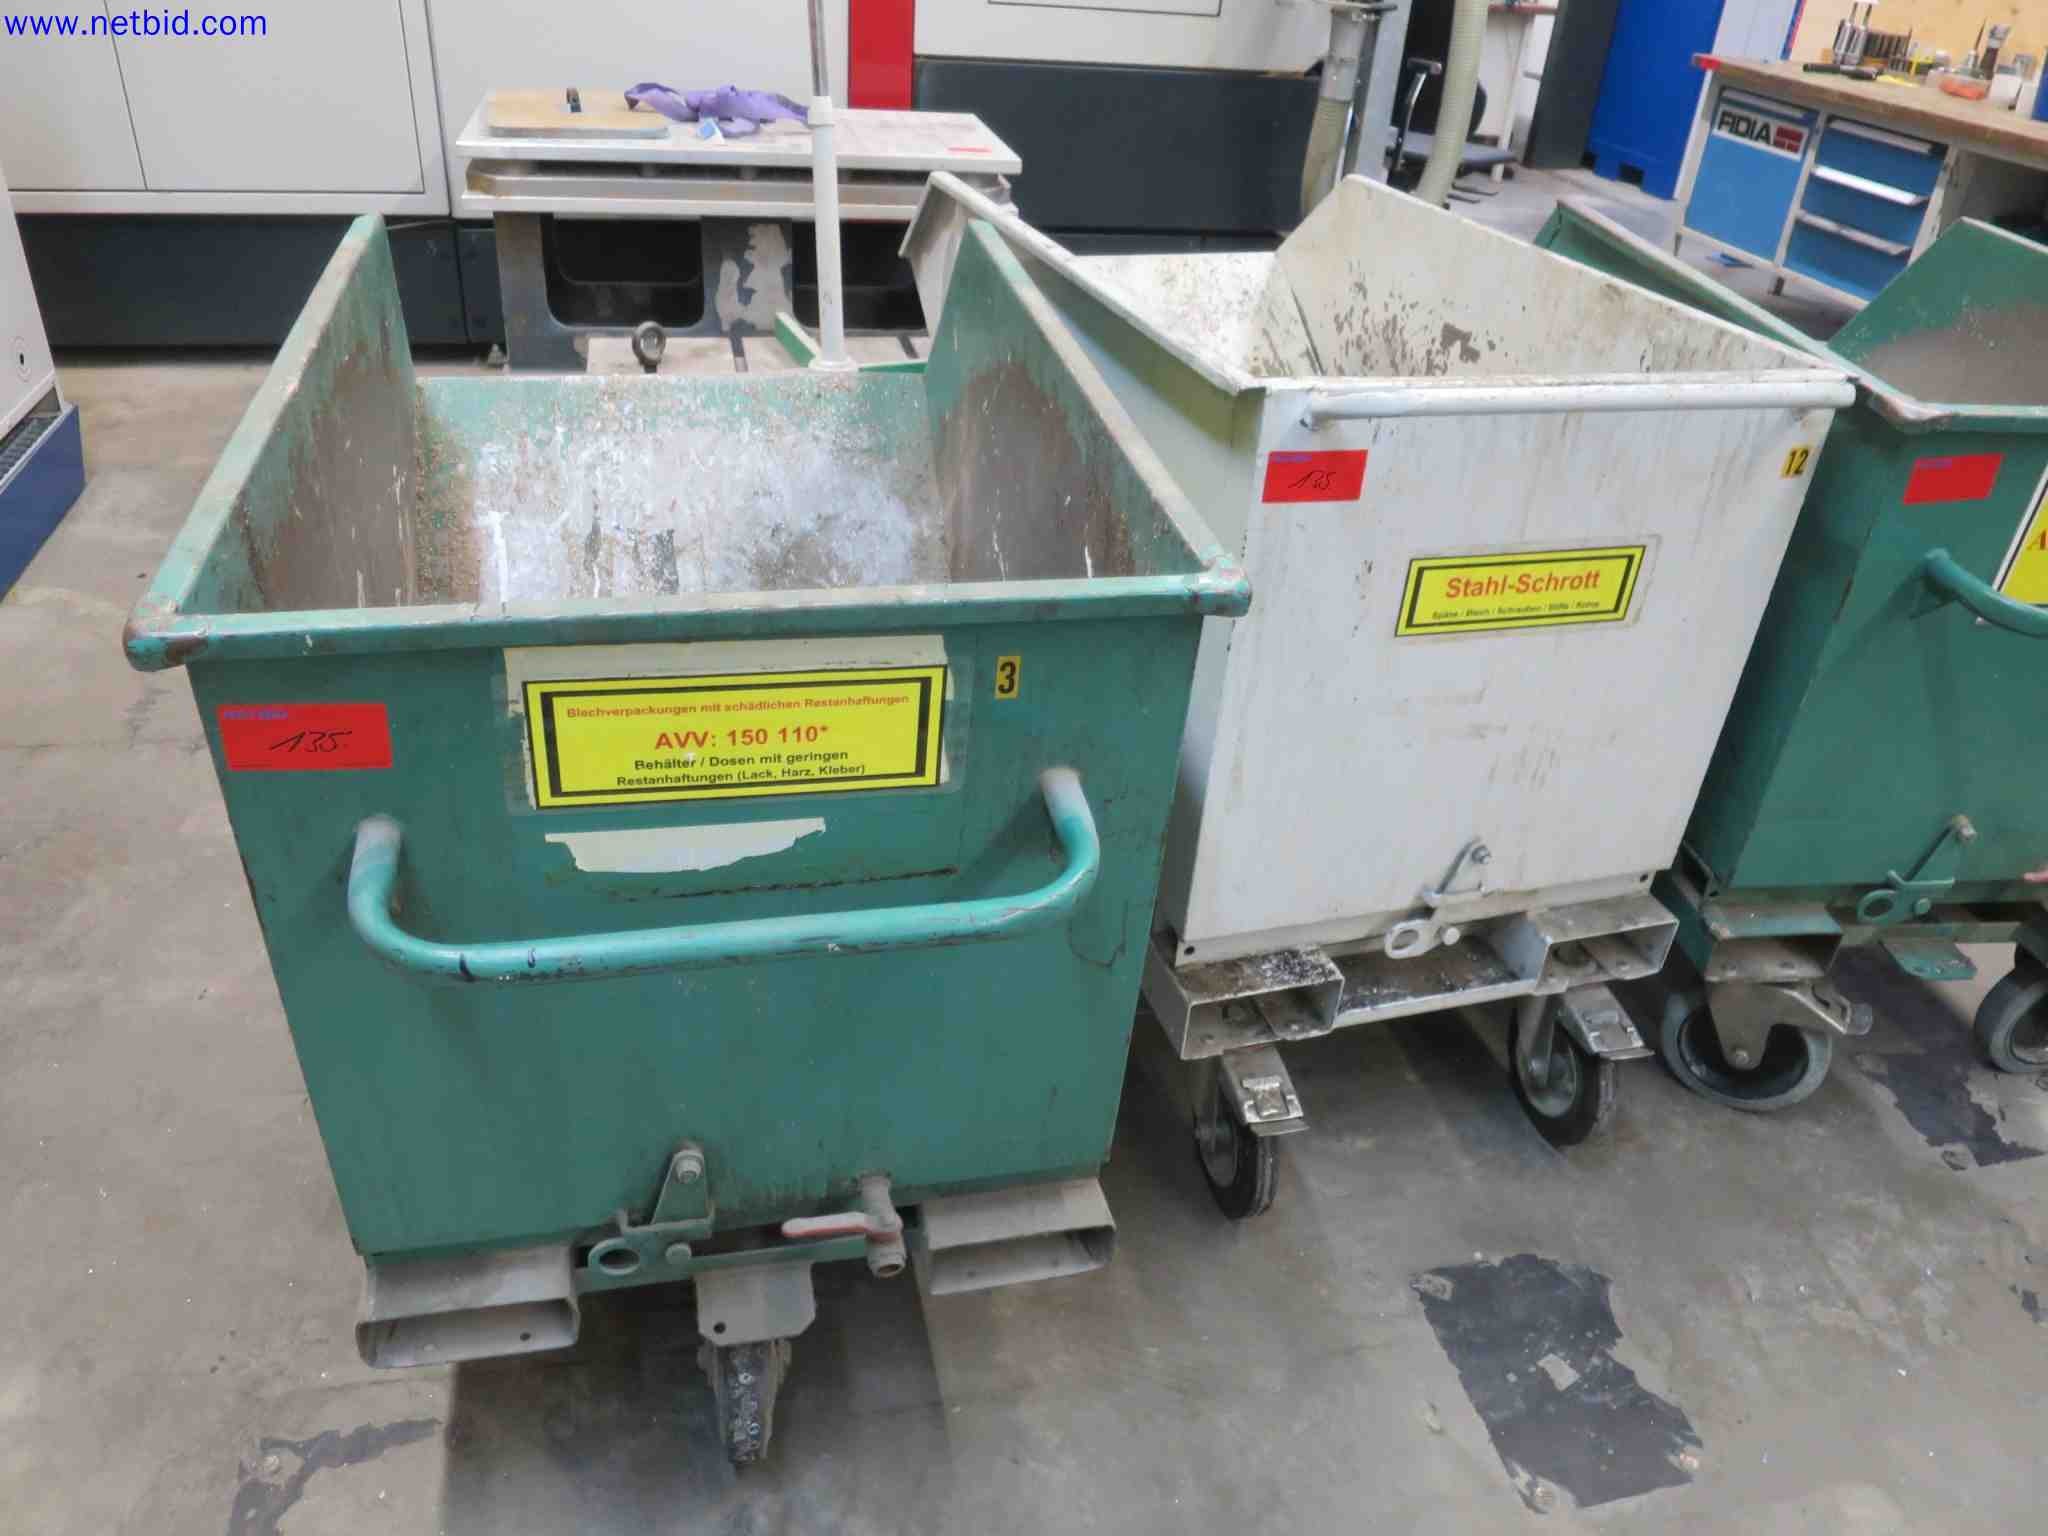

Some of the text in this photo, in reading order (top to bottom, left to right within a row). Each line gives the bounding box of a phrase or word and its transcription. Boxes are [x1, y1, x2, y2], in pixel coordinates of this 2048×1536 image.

[1784, 448, 1809, 475] 12
[1445, 570, 1600, 598] Stahl-Schrott
[998, 661, 1016, 694] 3
[567, 695, 910, 719] Blechverpackungen mit schädlichen Restanhaftungen
[270, 731, 353, 752] 135
[654, 730, 717, 750] AVV:
[726, 728, 769, 746] 150
[634, 757, 697, 771] Behälter
[709, 755, 756, 767] Dosen
[759, 753, 782, 765] mit
[786, 750, 849, 766] geringen
[616, 770, 734, 787] Restanhaftungen
[737, 768, 777, 782] (Lack,
[819, 763, 866, 777] Kleber)
